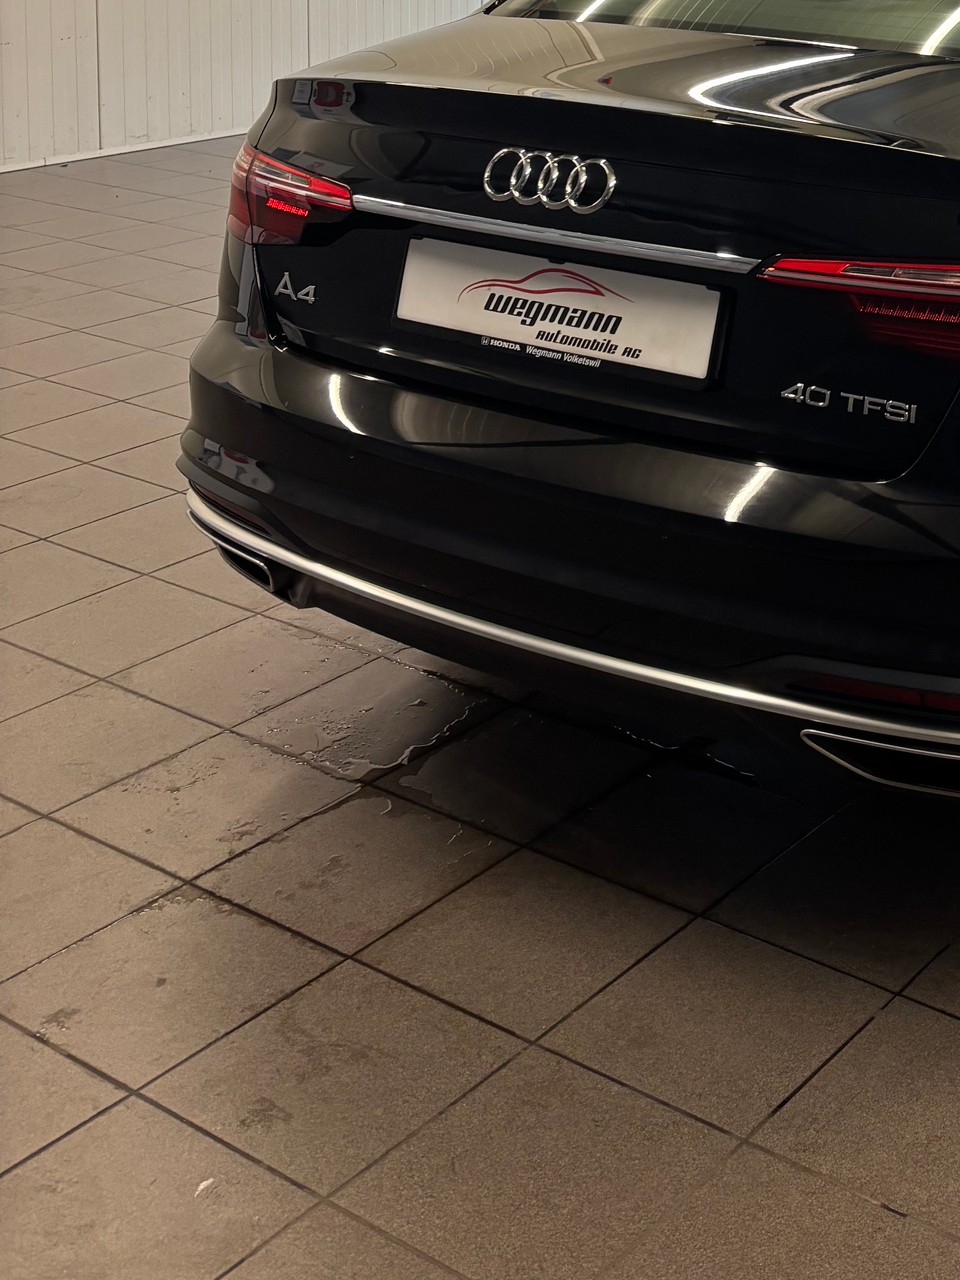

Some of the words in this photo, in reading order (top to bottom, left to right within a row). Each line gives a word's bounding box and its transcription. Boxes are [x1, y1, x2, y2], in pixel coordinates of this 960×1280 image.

[274, 272, 316, 304] A4
[484, 293, 623, 335] wegmann
[490, 339, 521, 352] HONDA
[525, 345, 562, 360] Wegmann
[563, 352, 602, 368] Volketswil
[622, 347, 643, 359] AG
[781, 383, 831, 408] 40
[840, 391, 918, 424] TFSI
